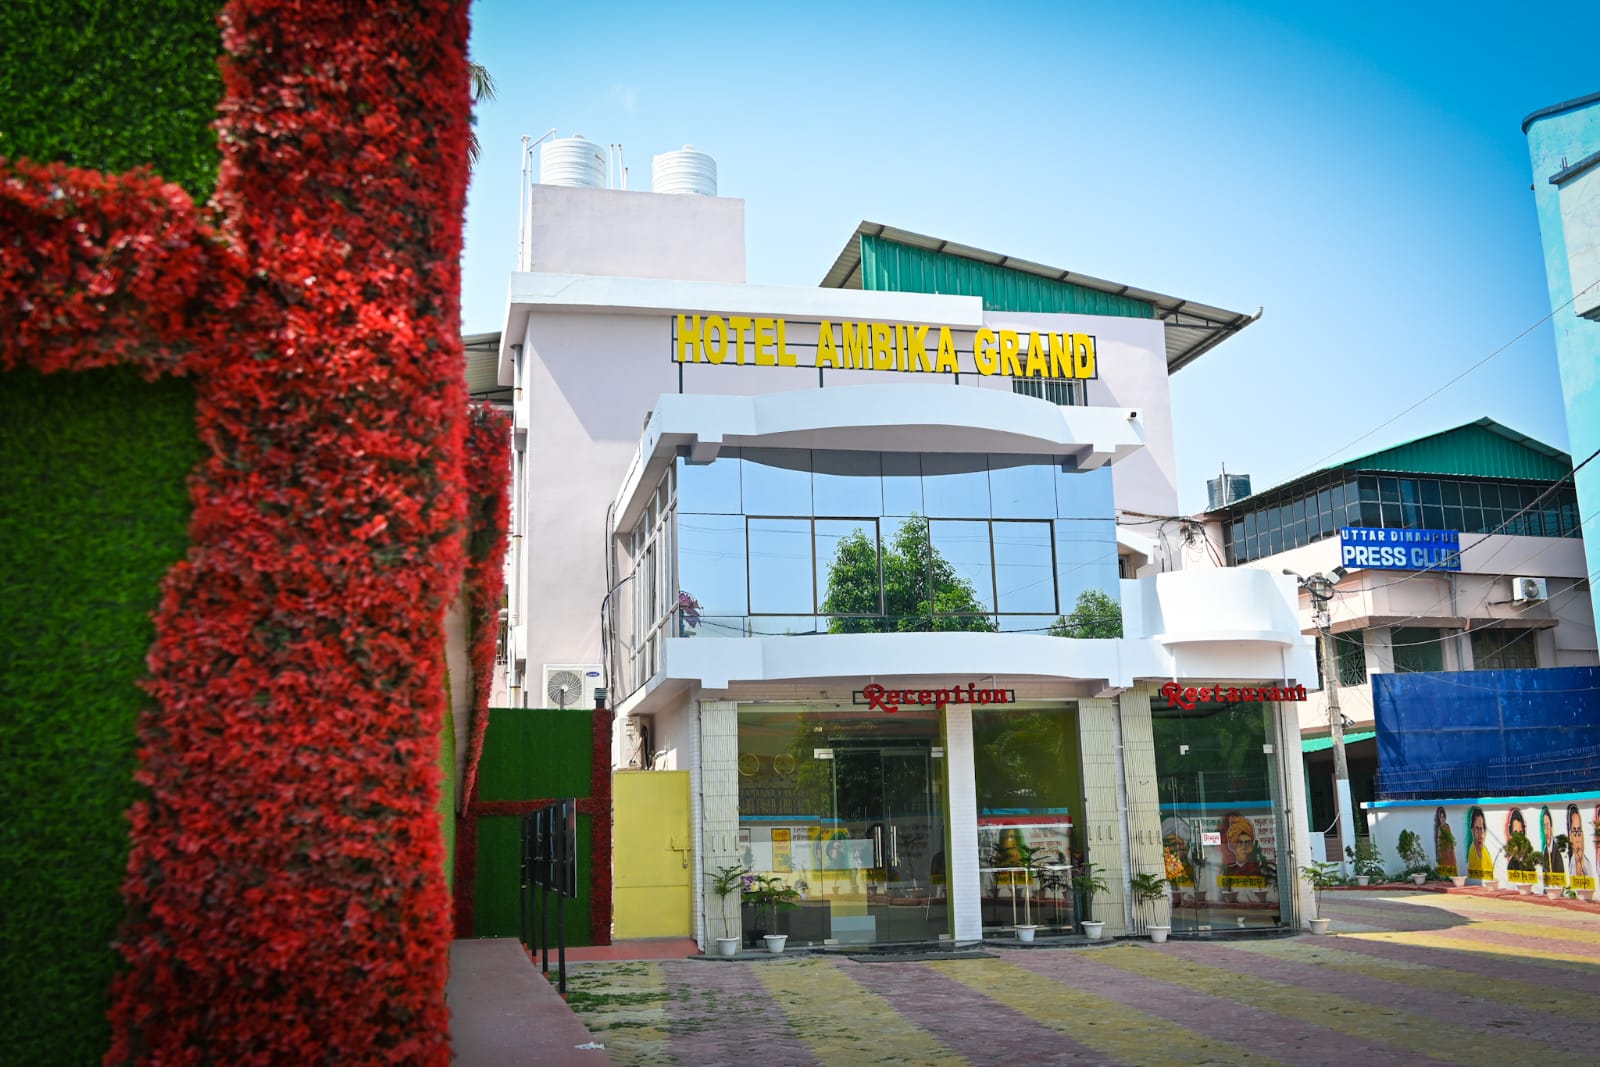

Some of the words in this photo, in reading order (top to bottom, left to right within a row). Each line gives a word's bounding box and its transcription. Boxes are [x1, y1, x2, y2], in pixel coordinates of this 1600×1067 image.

[677, 314, 797, 367] HOTEL
[816, 320, 959, 373] AMBIKA
[974, 328, 1096, 379] GRAND
[1341, 529, 1385, 541] UTTAR
[1342, 546, 1407, 567] PRESS
[1411, 548, 1460, 568] CLUB
[863, 682, 1008, 713] Reception
[1162, 682, 1307, 710] Restaurant
